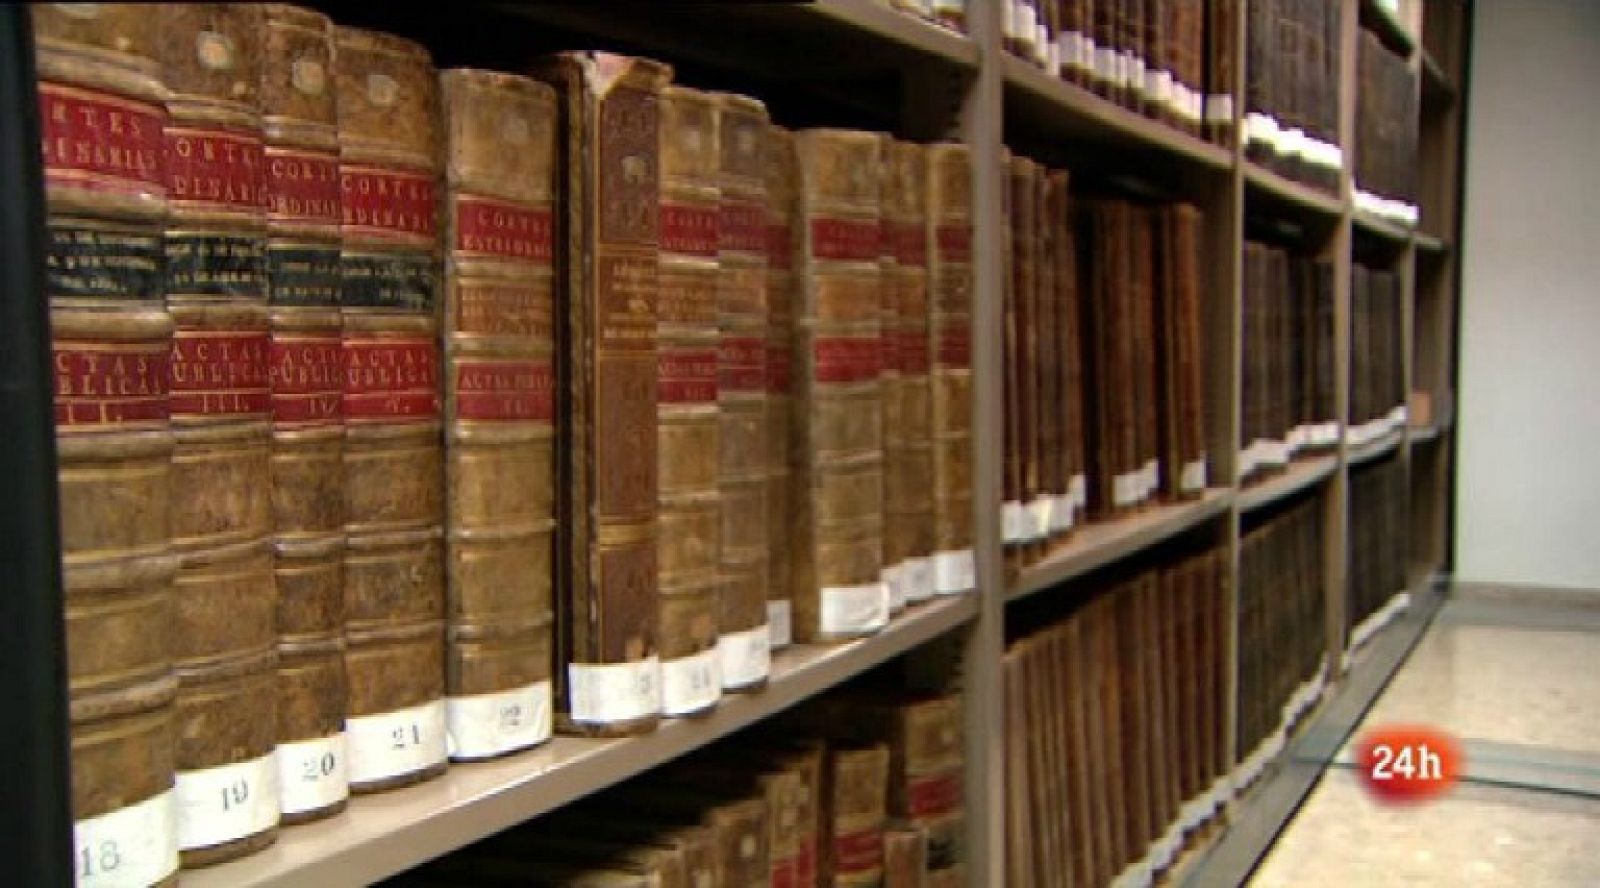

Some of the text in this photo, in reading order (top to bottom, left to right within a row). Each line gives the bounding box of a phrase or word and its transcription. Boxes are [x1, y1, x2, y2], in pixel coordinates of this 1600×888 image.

[391, 722, 421, 750] 21
[302, 751, 335, 781] 20
[221, 779, 249, 811] 19
[79, 840, 121, 877] 18
